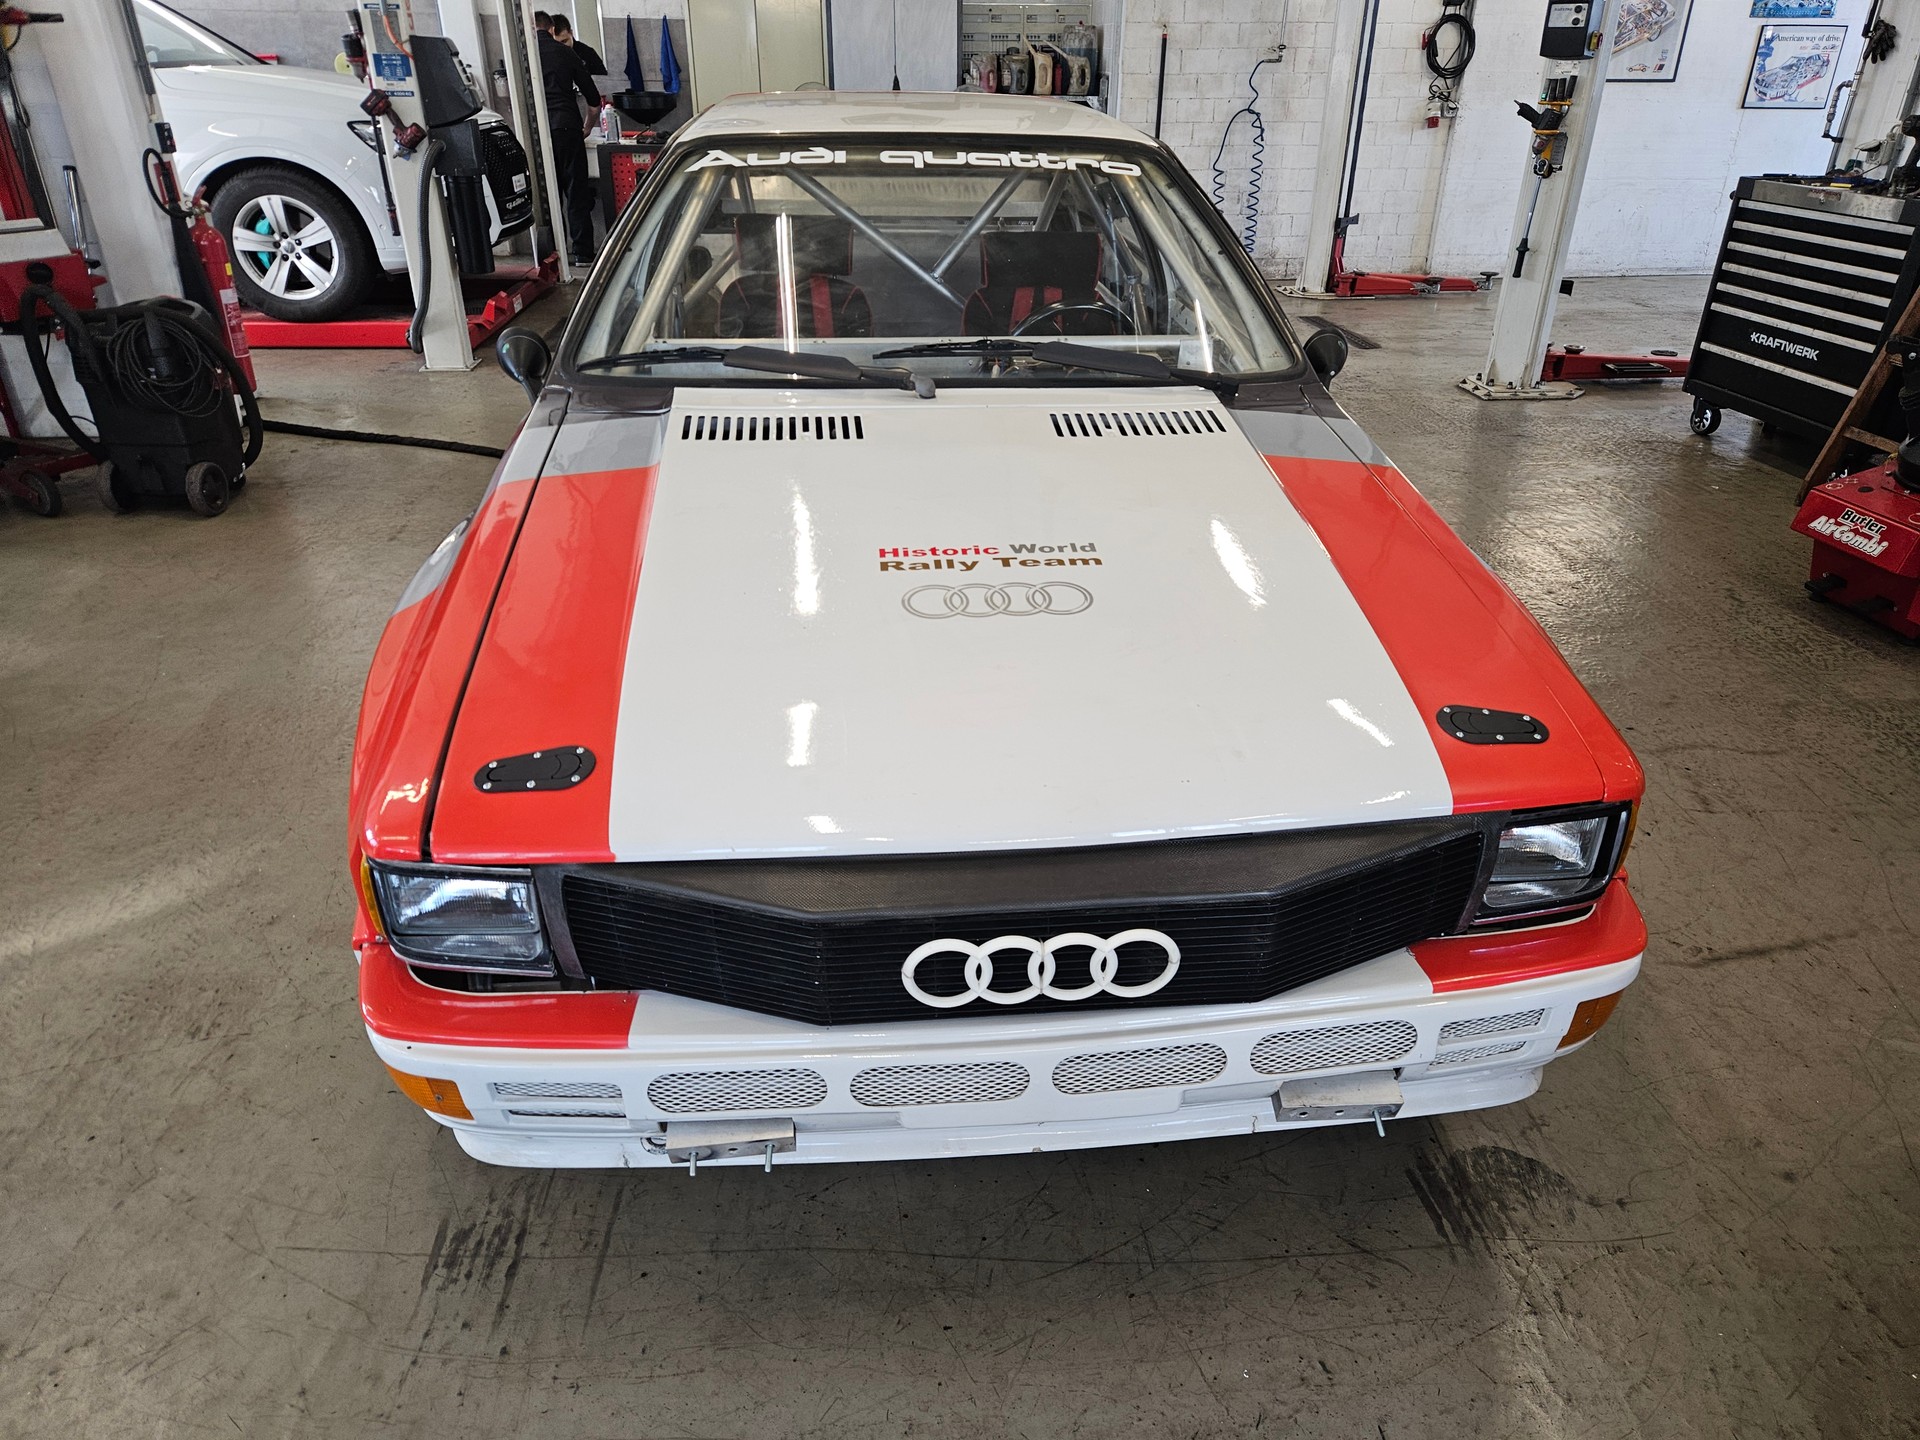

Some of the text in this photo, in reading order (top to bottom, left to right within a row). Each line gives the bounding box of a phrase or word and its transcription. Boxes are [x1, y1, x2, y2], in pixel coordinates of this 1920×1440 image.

[1775, 34, 1804, 42] American
[684, 147, 1142, 177] Audi quattro
[1750, 332, 1820, 361] KRAFTWERK
[1808, 515, 1889, 557] AirCombi
[1840, 509, 1886, 536] Butler
[878, 542, 1097, 558] Historic World
[879, 556, 1103, 572] Rally Team
